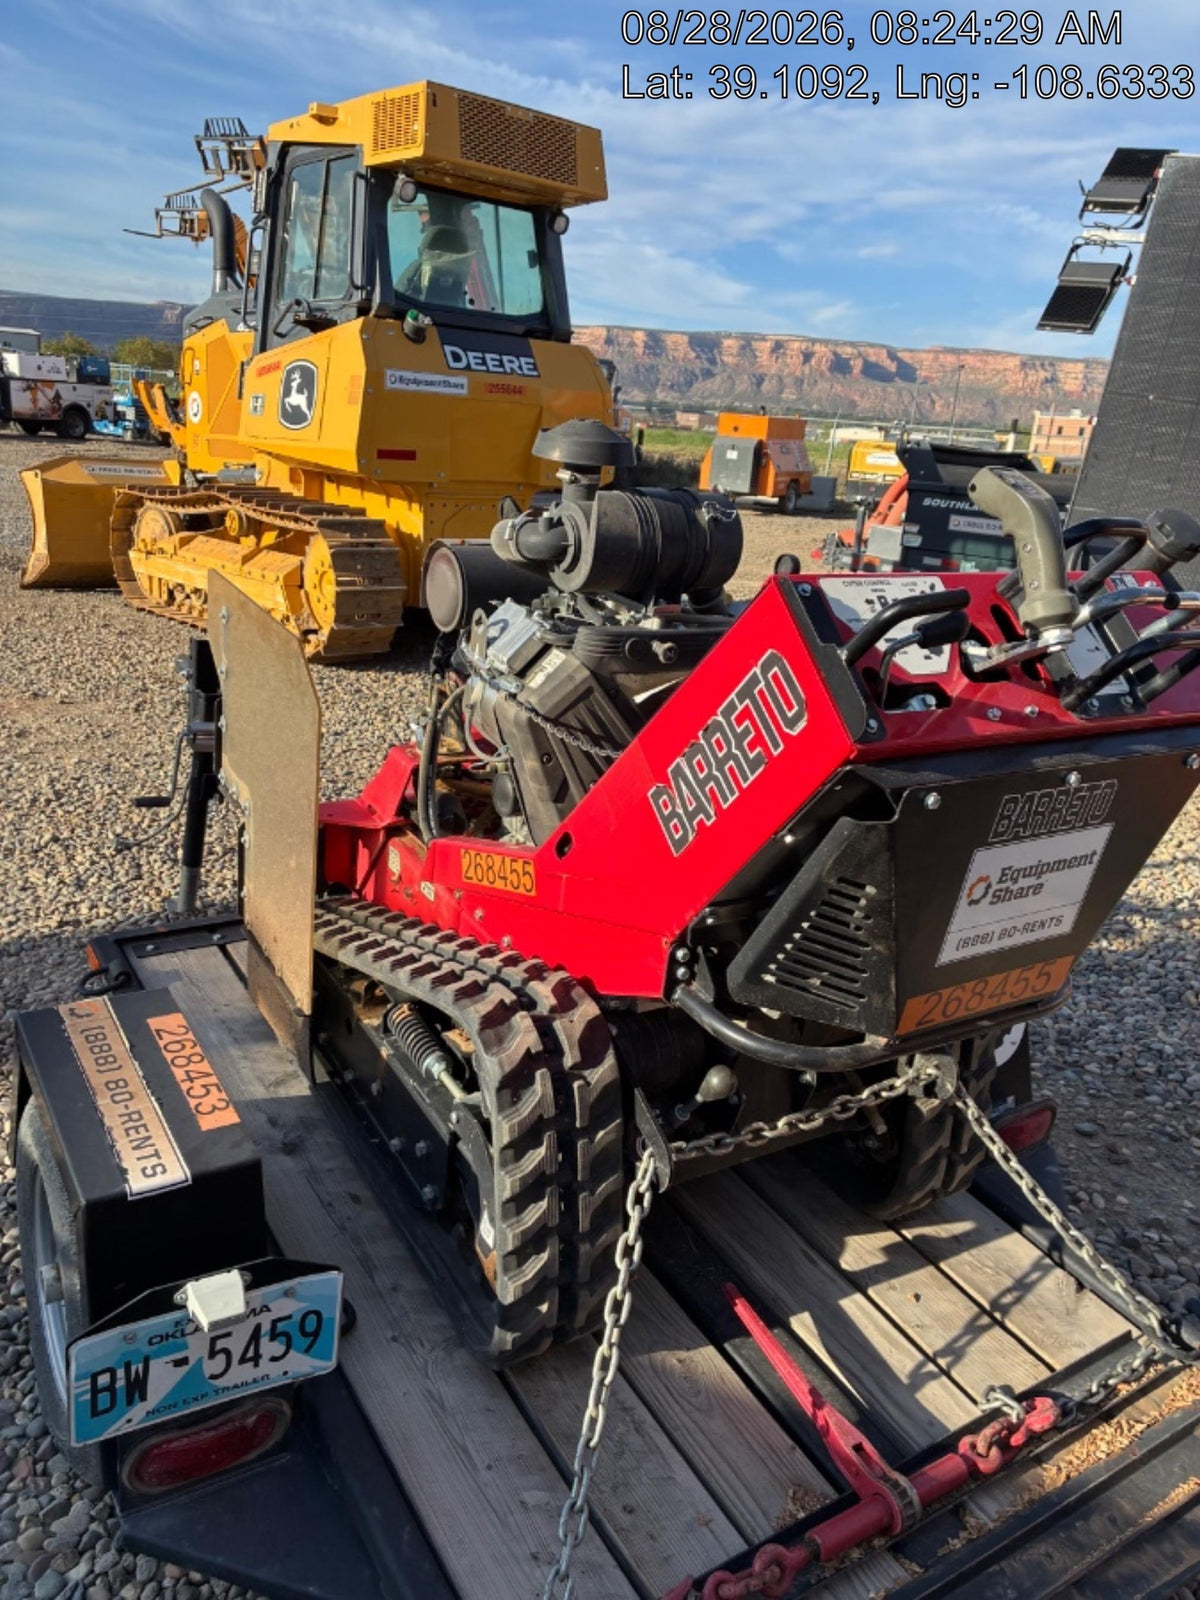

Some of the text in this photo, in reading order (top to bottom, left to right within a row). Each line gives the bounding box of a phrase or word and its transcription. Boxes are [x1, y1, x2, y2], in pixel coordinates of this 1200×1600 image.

[443, 344, 539, 376] DEERE
[922, 497, 979, 511] SOUTHLA
[647, 648, 808, 858] BARRETO
[988, 778, 1118, 842] BARRETO
[463, 850, 534, 893] 268455
[996, 850, 1098, 885] Equipment
[989, 881, 1045, 906] Share
[956, 915, 1064, 951] (888) 80-RENTS
[915, 966, 1052, 1027] 268455
[154, 1024, 230, 1116] 268453
[80, 1026, 168, 1179] (888) 80-RENTS
[90, 1309, 323, 1419] BW 5459
[145, 1402, 178, 1417] NON
[213, 1374, 271, 1396] TRAILER
